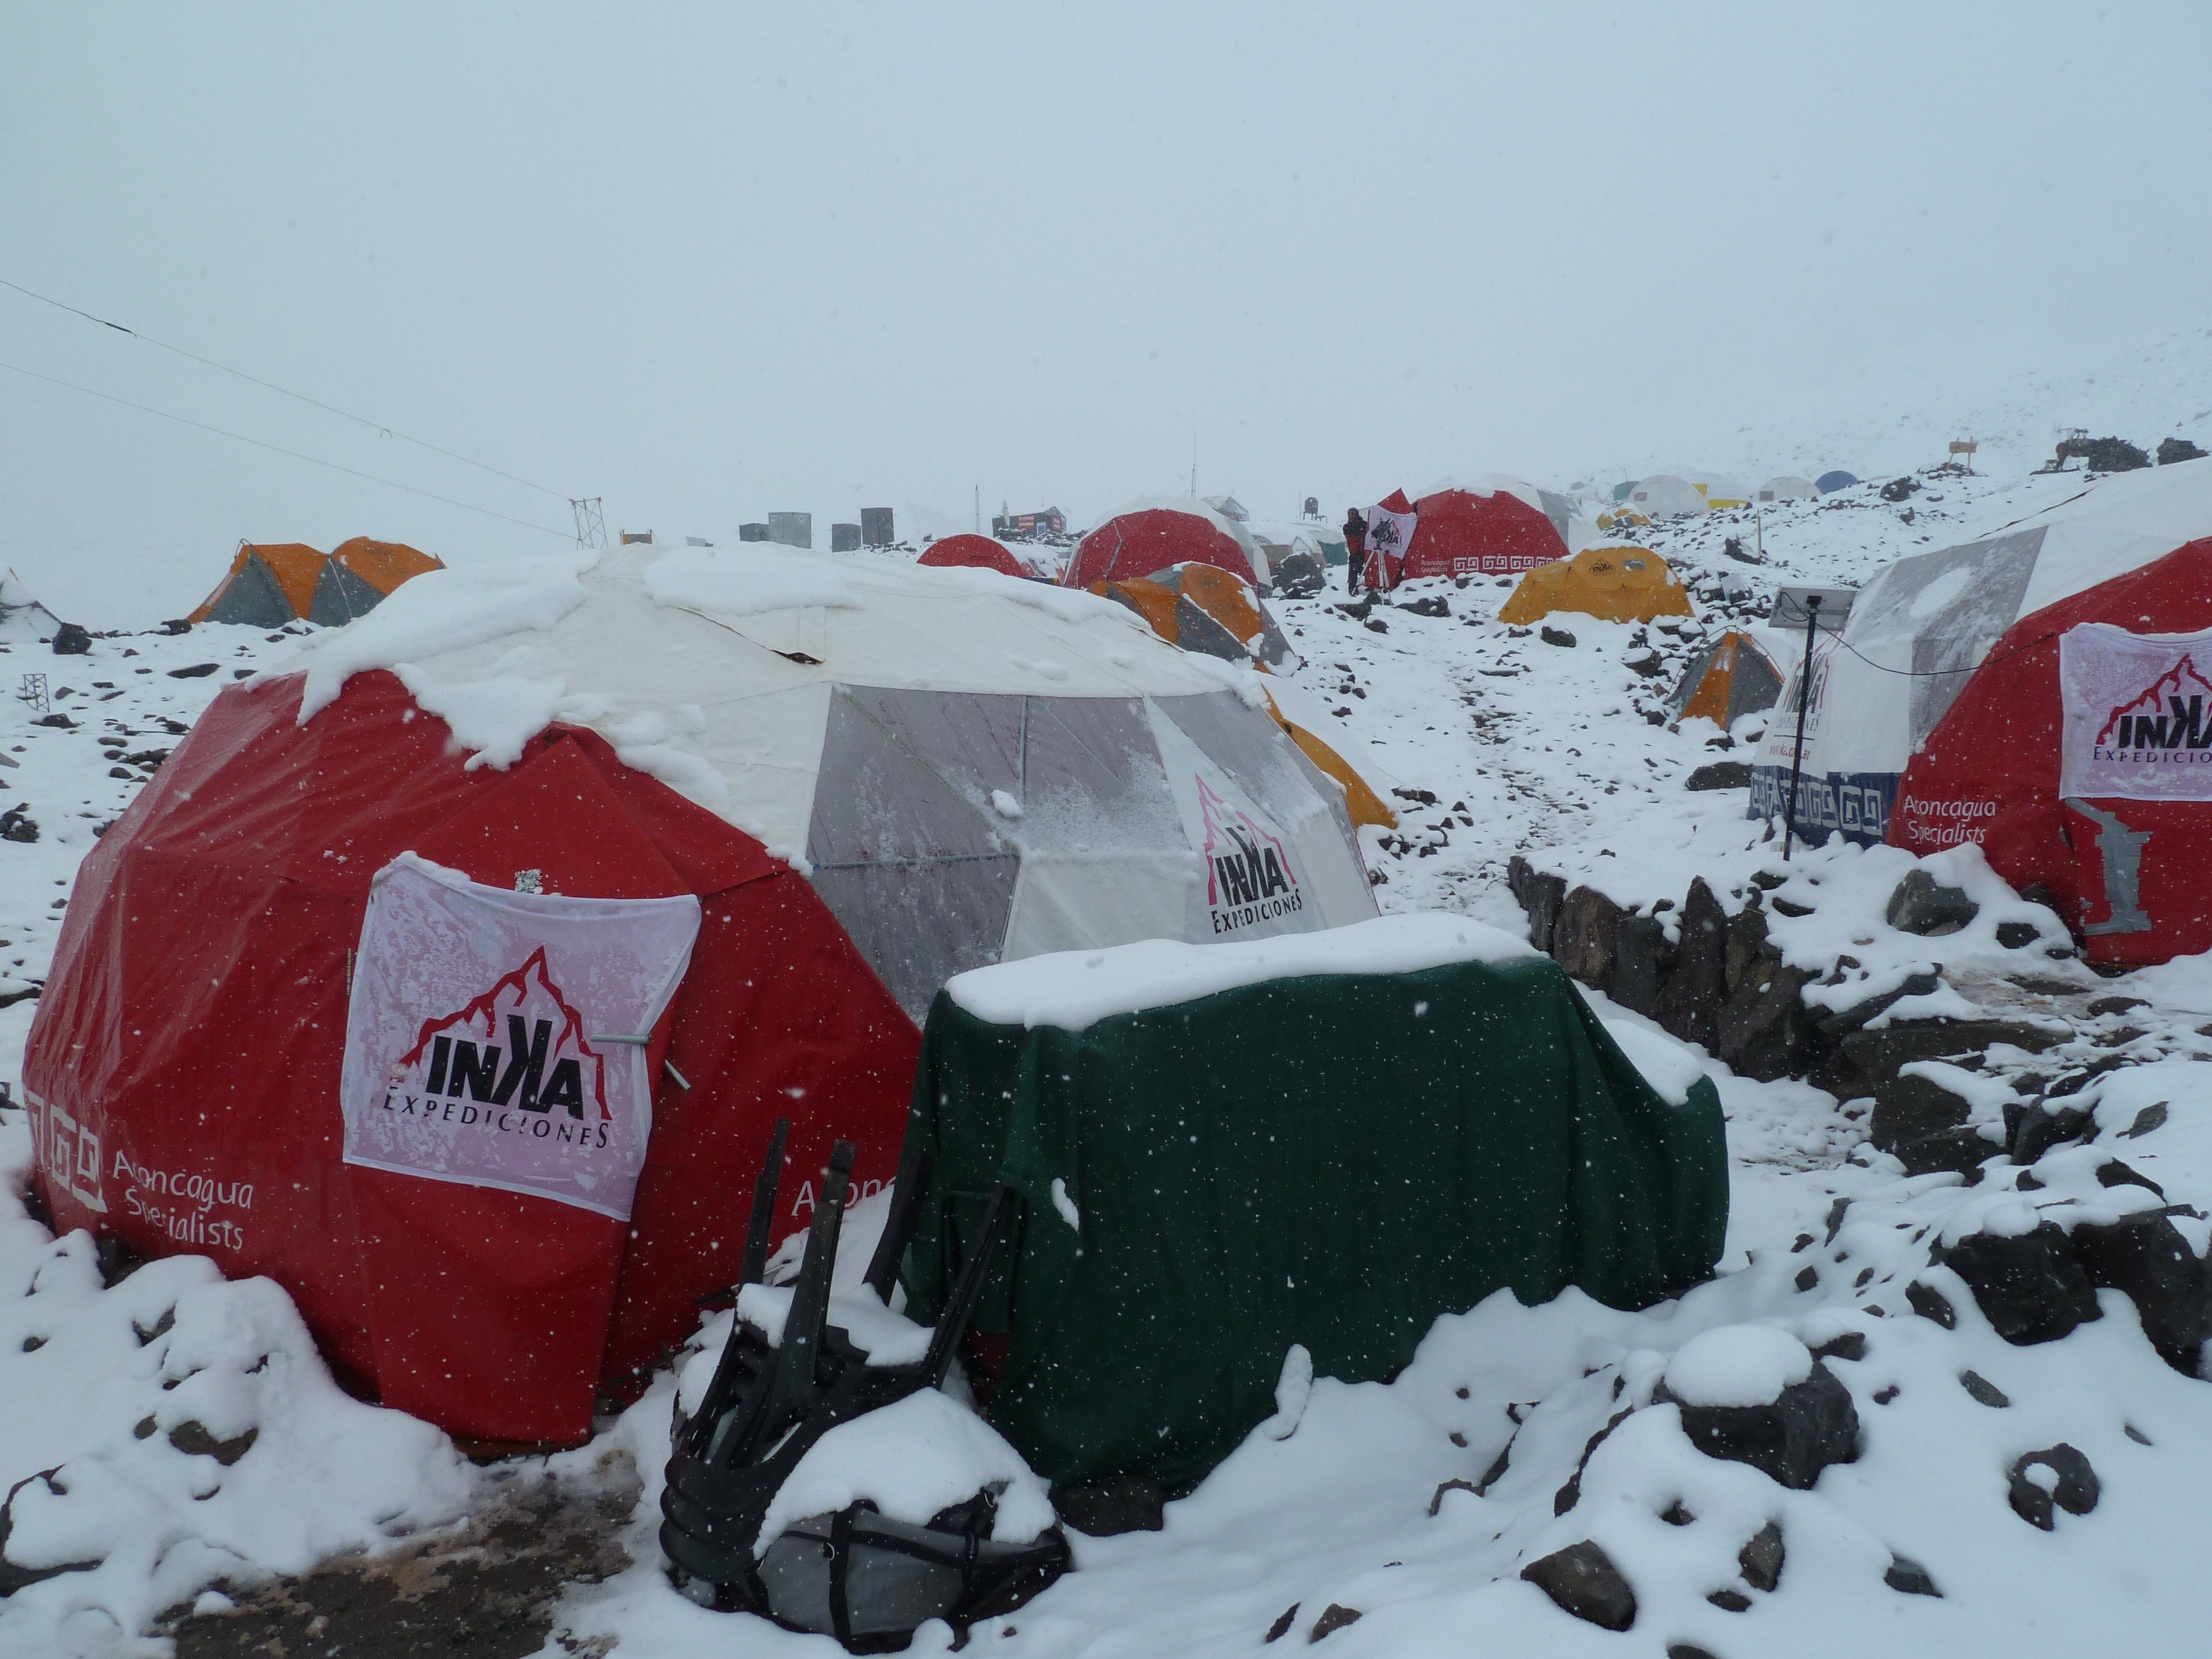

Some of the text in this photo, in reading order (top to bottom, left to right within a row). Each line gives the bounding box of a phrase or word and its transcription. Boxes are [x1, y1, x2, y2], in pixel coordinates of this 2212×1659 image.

[1908, 820, 1987, 844] Specialists
[1215, 826, 1290, 907] INKA
[1211, 888, 1302, 934] EXPEDICIONES
[425, 1014, 584, 1120] INKA
[383, 1086, 609, 1149] EXPEDICIONES
